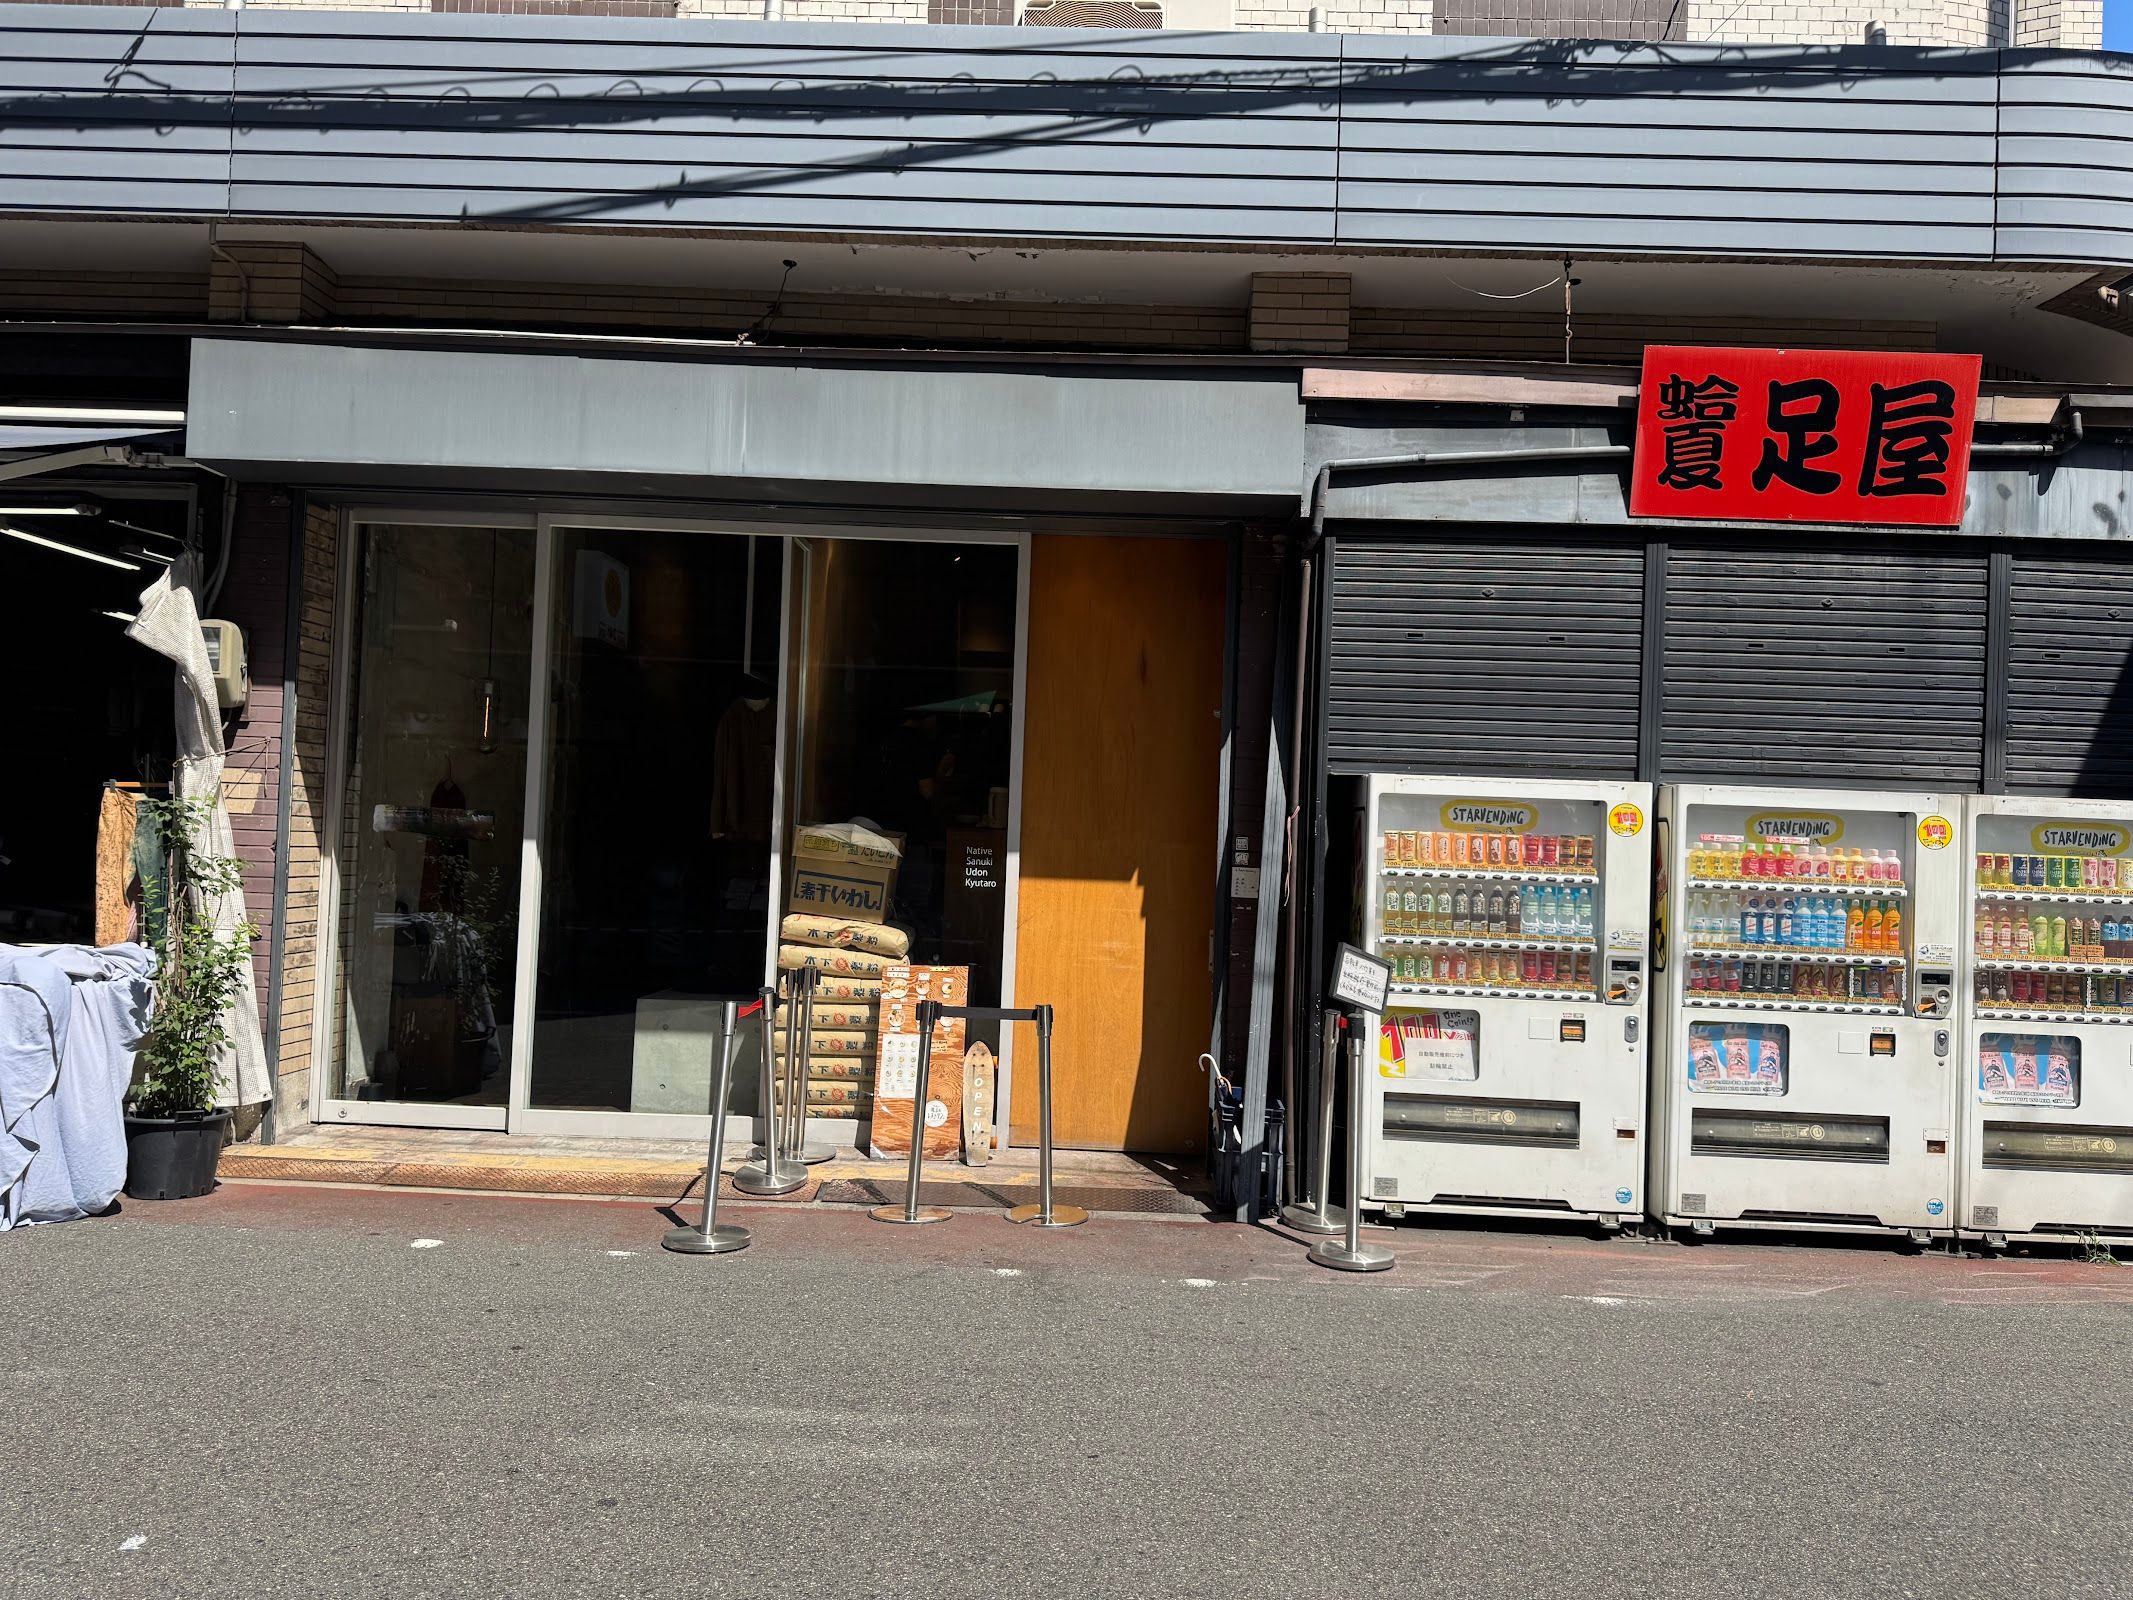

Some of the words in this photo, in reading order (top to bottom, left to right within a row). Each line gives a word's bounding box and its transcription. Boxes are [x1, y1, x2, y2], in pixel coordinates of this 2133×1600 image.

[966, 846, 993, 855] Native
[966, 856, 993, 866] Sanuki
[966, 868, 988, 876] Udon
[965, 878, 996, 888] Kyutaro
[800, 881, 878, 910] 煮干いわし
[815, 986, 880, 998] 下製粉
[812, 1014, 876, 1024] 下製粉
[973, 1078, 983, 1130] OPEN
